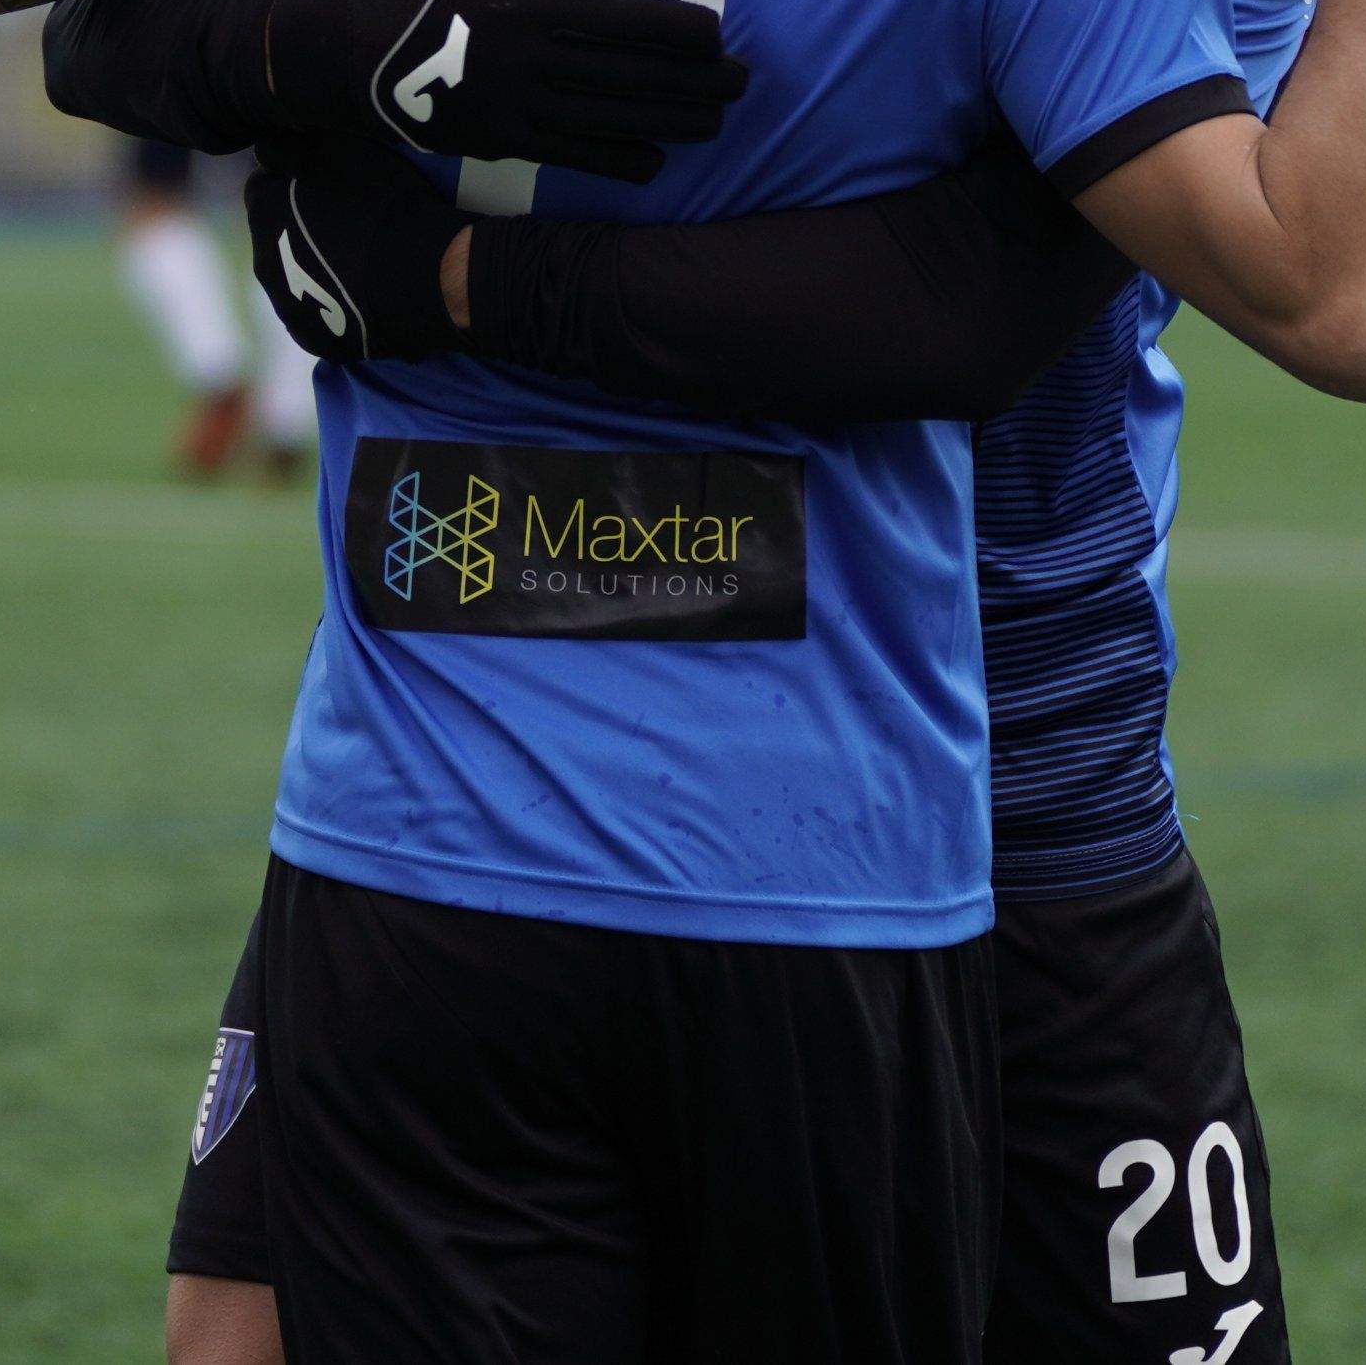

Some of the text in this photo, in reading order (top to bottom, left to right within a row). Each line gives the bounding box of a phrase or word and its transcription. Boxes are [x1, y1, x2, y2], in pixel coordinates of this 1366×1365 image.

[523, 494, 753, 564] Maxtar
[520, 569, 740, 597] SOLUTIONS
[1098, 1120, 1251, 1303] 20
